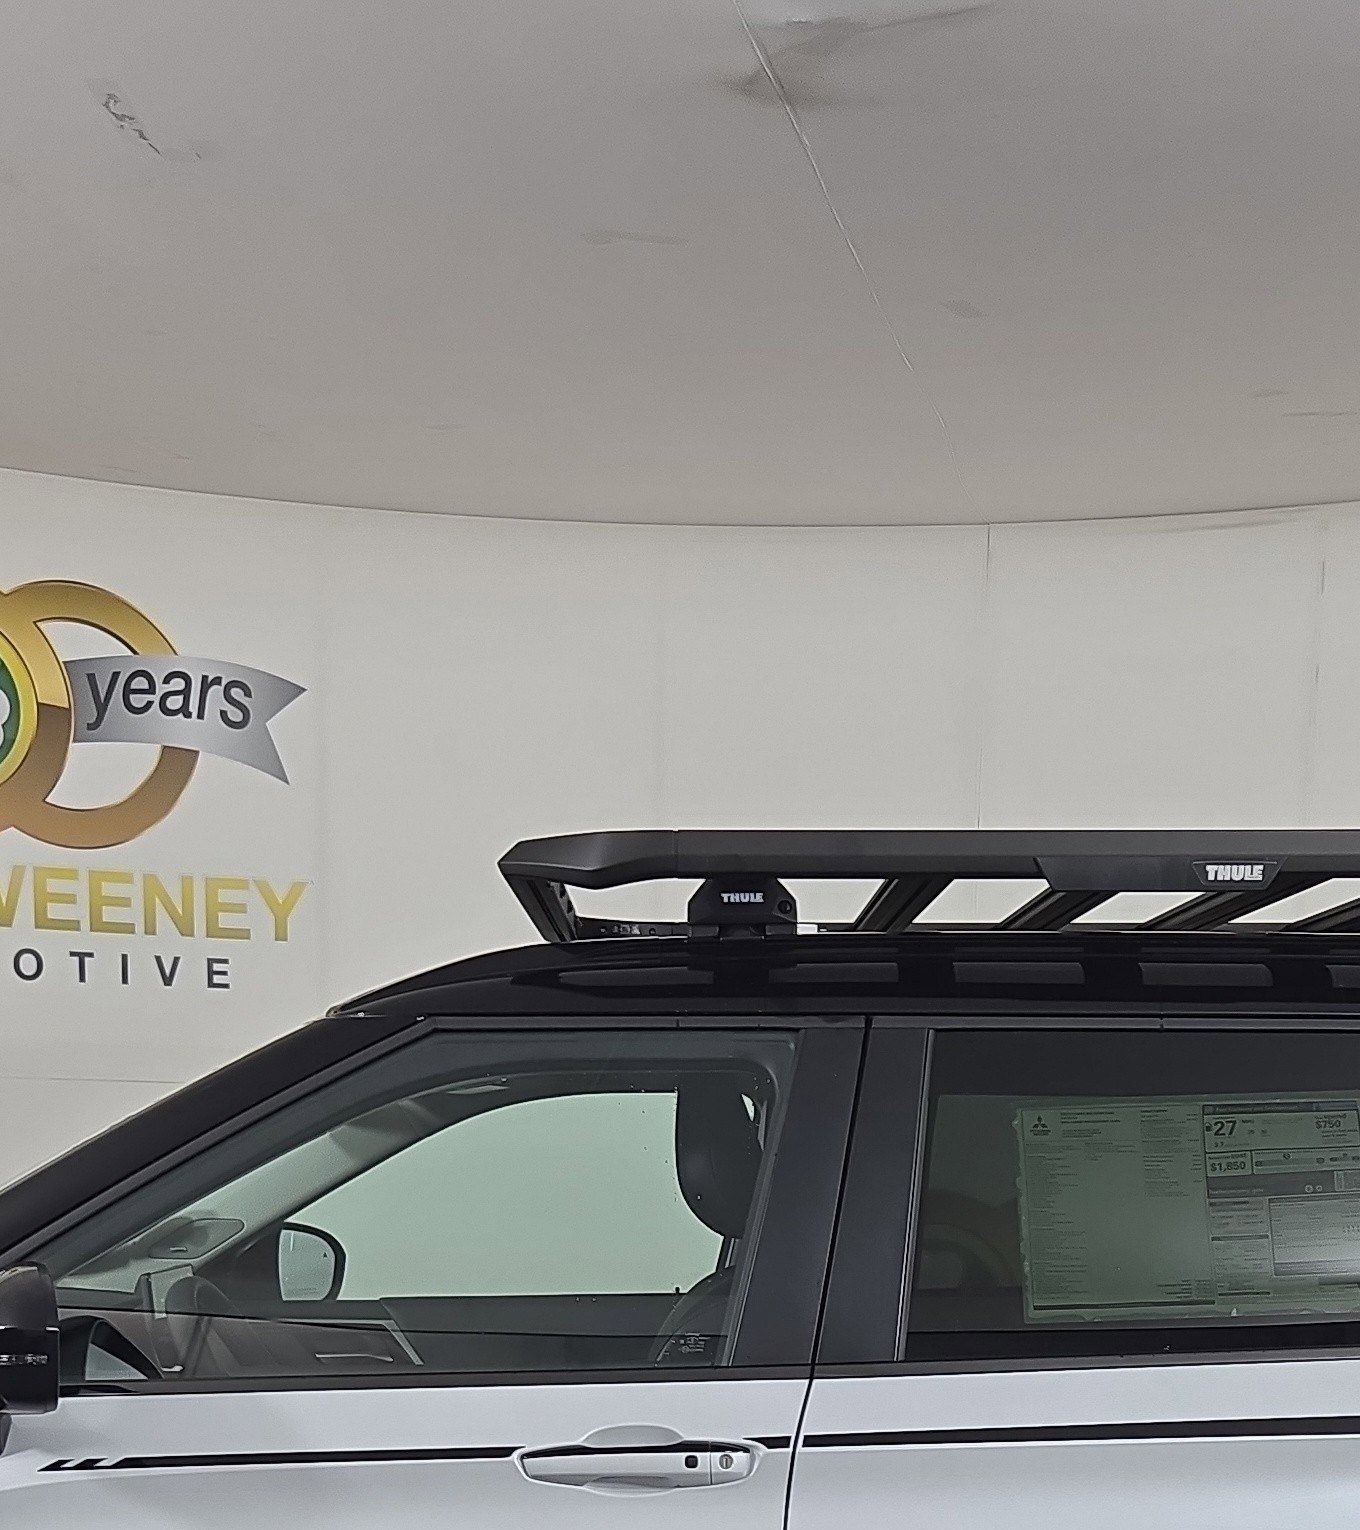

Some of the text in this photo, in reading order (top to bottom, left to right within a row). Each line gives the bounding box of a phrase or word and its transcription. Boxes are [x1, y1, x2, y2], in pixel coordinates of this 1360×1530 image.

[85, 668, 253, 731] years
[1205, 864, 1265, 881] THULE
[720, 892, 765, 903] THULE
[1213, 1120, 1237, 1137] 27
